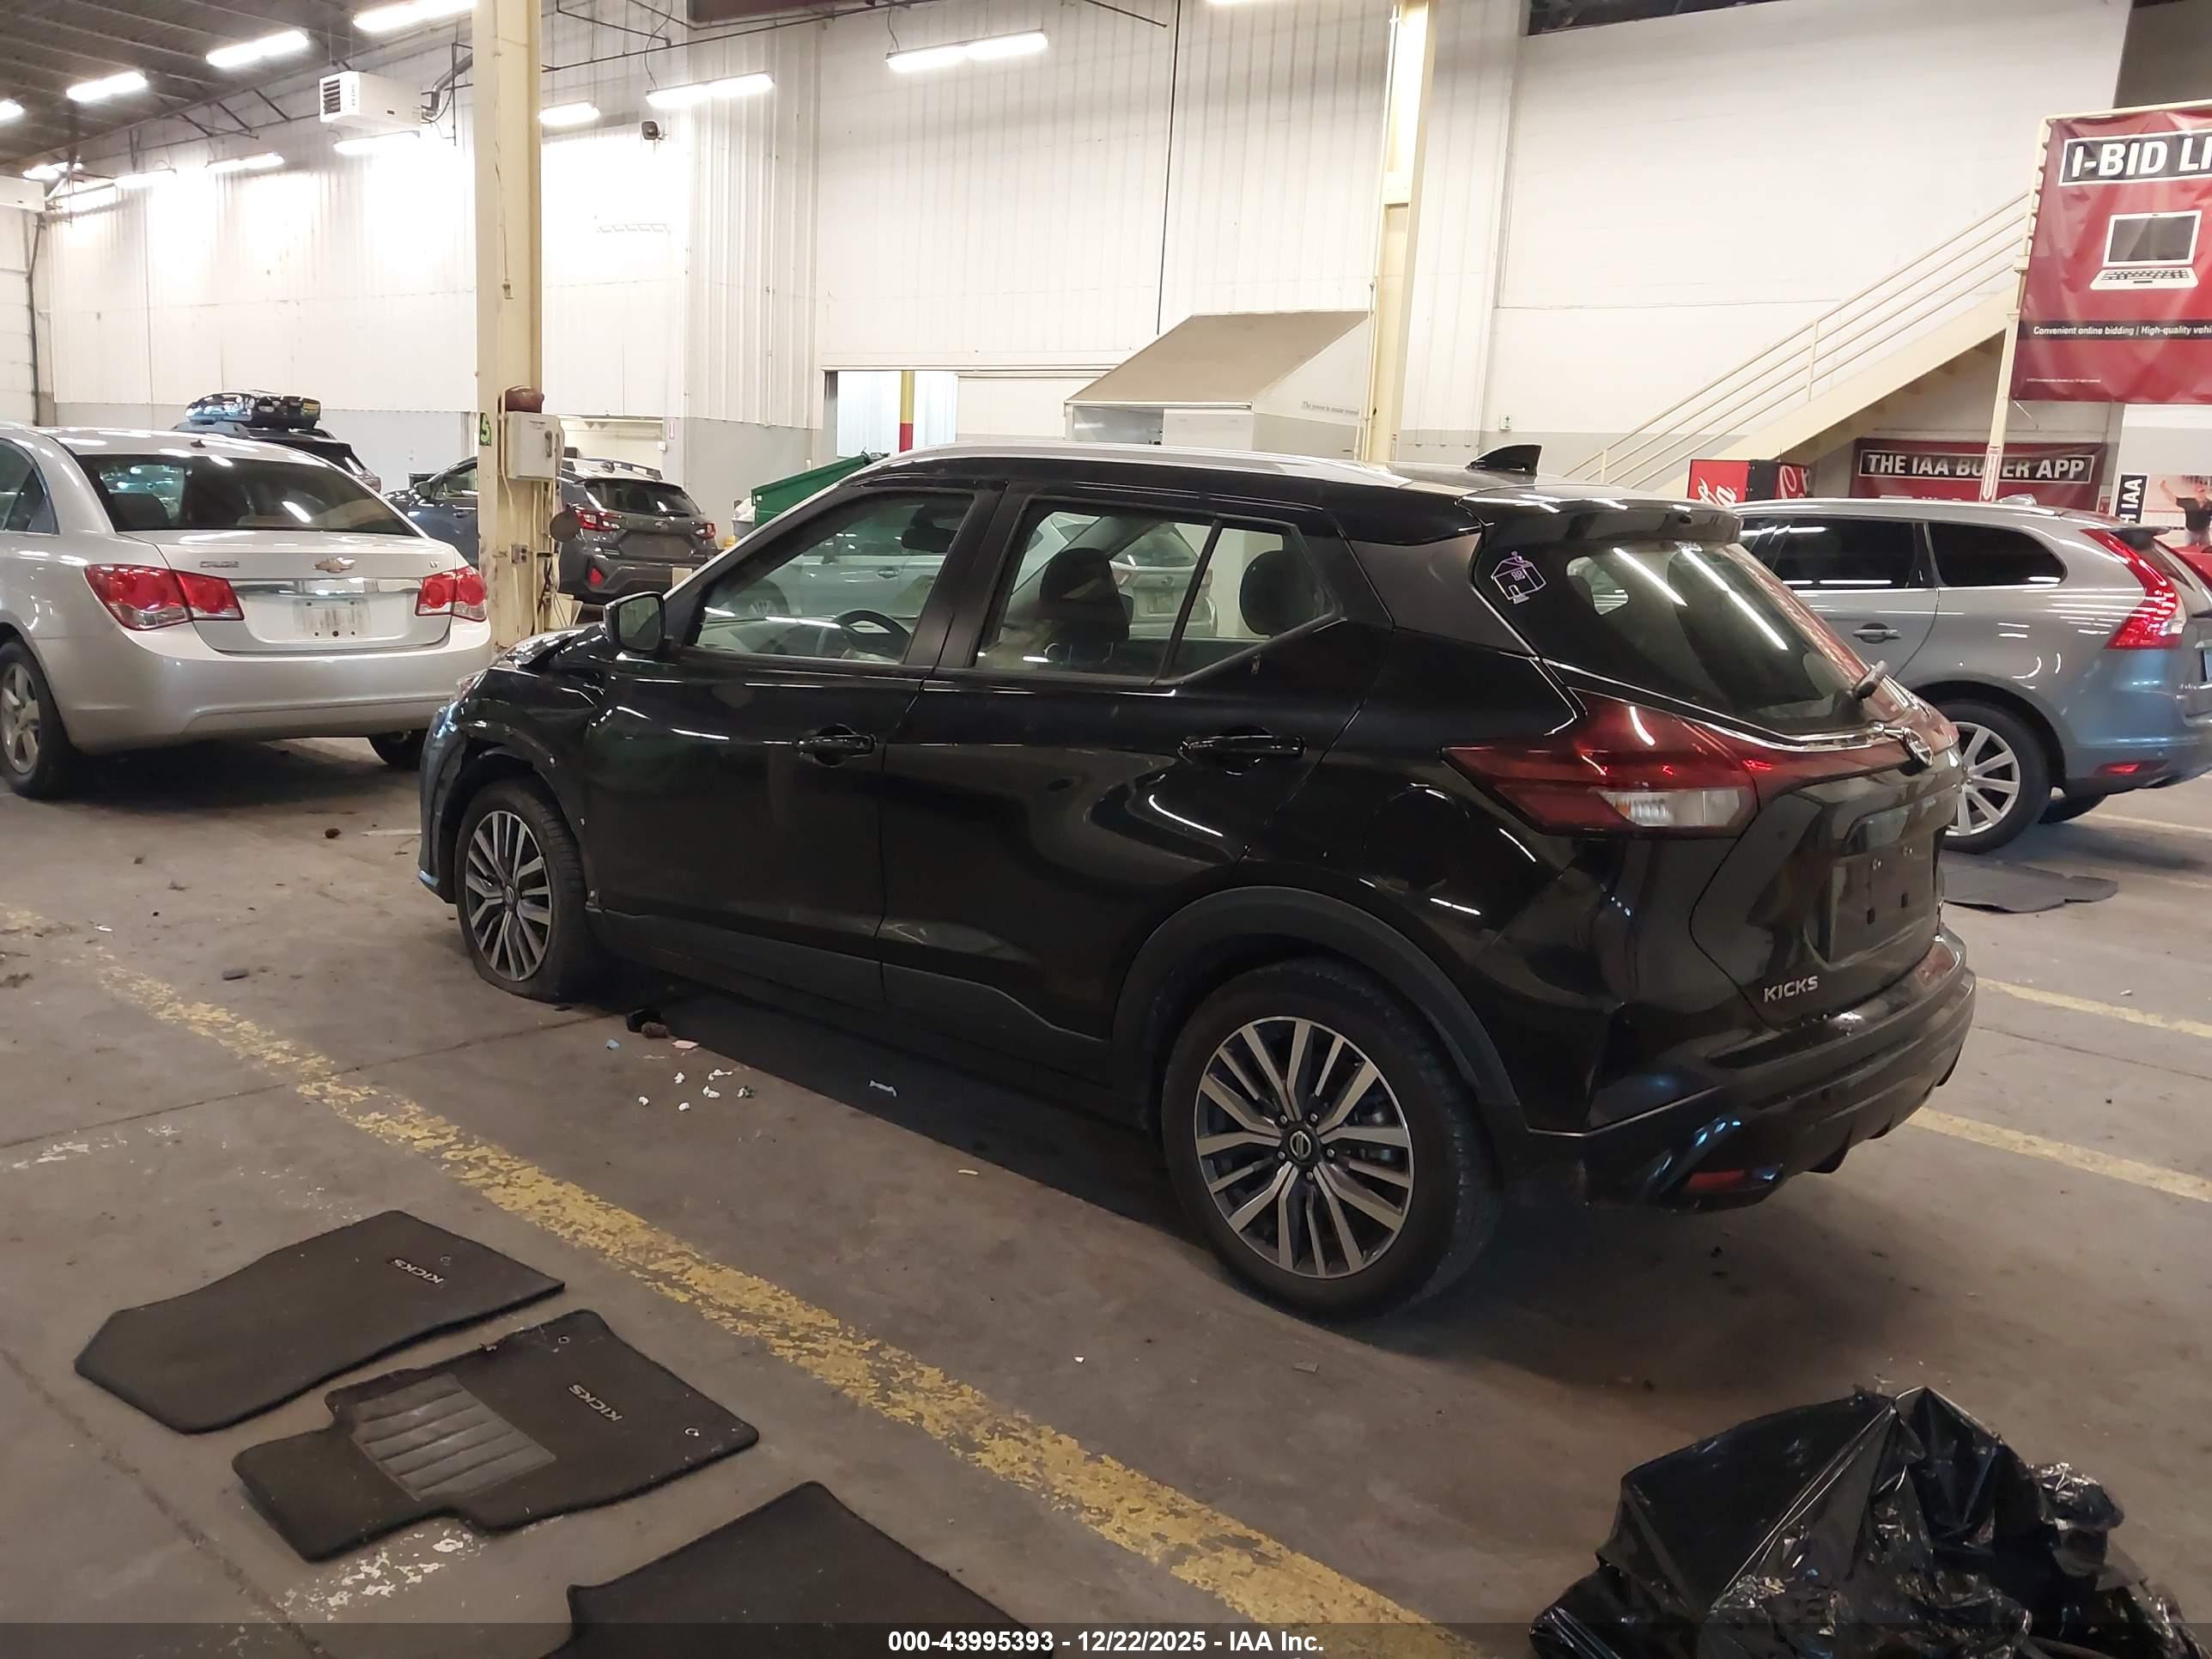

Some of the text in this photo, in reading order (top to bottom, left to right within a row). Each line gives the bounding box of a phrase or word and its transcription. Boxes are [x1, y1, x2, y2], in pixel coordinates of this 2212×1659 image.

[2071, 141, 2168, 178] I-BID
[2033, 325, 2076, 335] Convenient
[2078, 326, 2103, 335] online
[2105, 325, 2134, 336] bidding
[2141, 325, 2191, 336] High-quality
[1868, 454, 1906, 474] THE
[1911, 456, 1949, 476] IAA
[1955, 458, 2030, 478] BUER
[2036, 459, 2085, 479] APP
[2121, 478, 2142, 509] IAA
[1764, 975, 1819, 1003] KICKS
[392, 1259, 445, 1284] KICKS
[568, 1384, 623, 1421] KICKS
